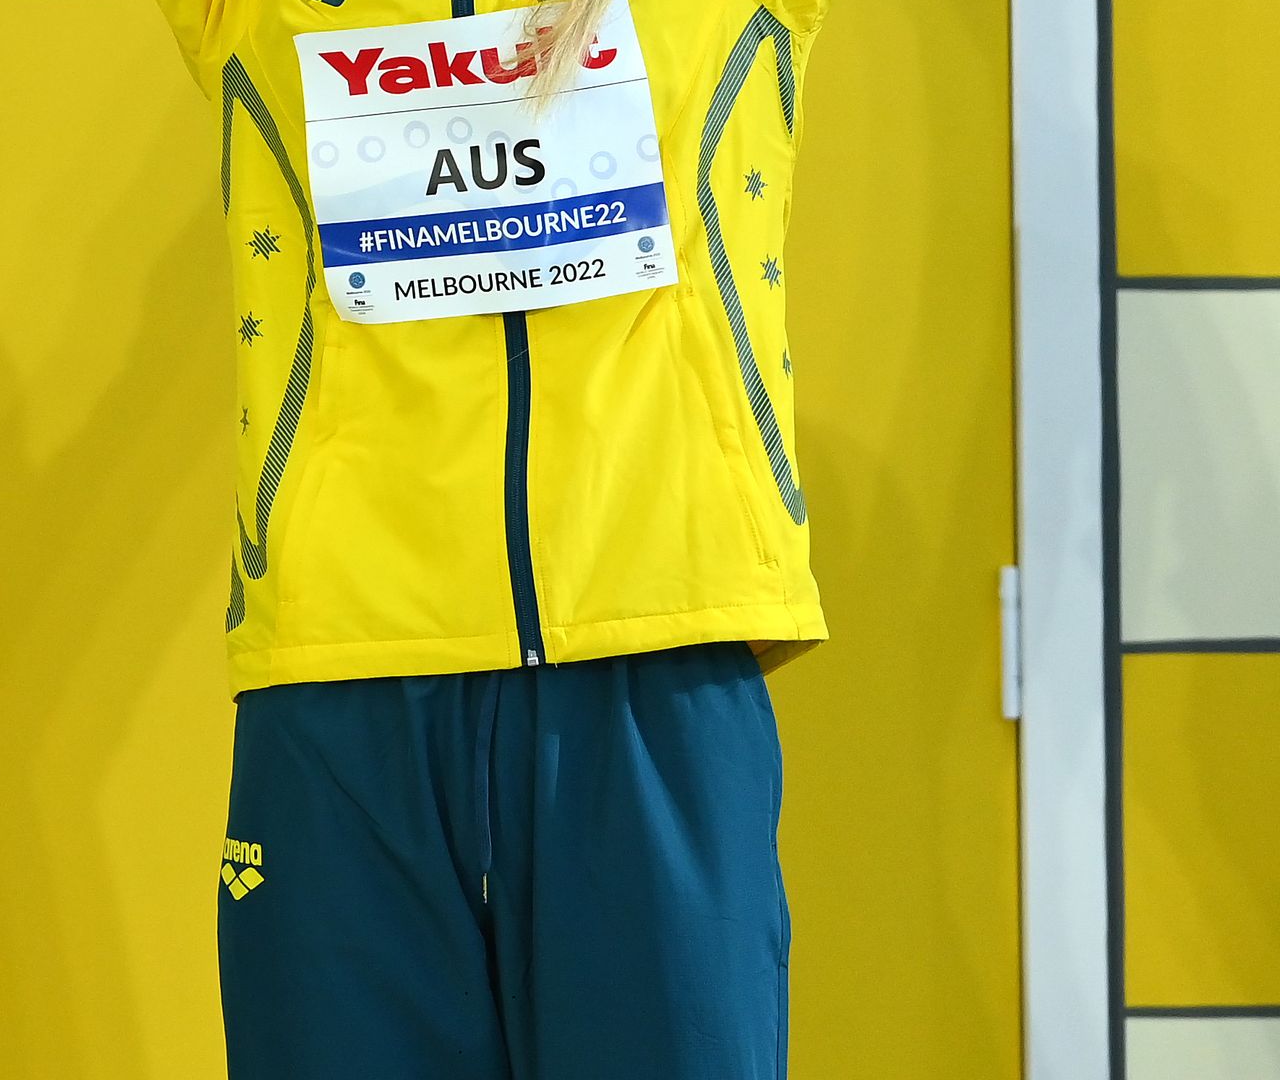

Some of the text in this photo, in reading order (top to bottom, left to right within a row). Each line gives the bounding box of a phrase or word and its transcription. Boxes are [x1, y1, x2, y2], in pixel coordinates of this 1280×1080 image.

[425, 138, 546, 196] AUS
[359, 201, 628, 253] #FINAMELBOURNE22
[394, 268, 543, 301] MELBOURNE
[548, 258, 606, 286] 2022
[223, 837, 262, 866] arena
